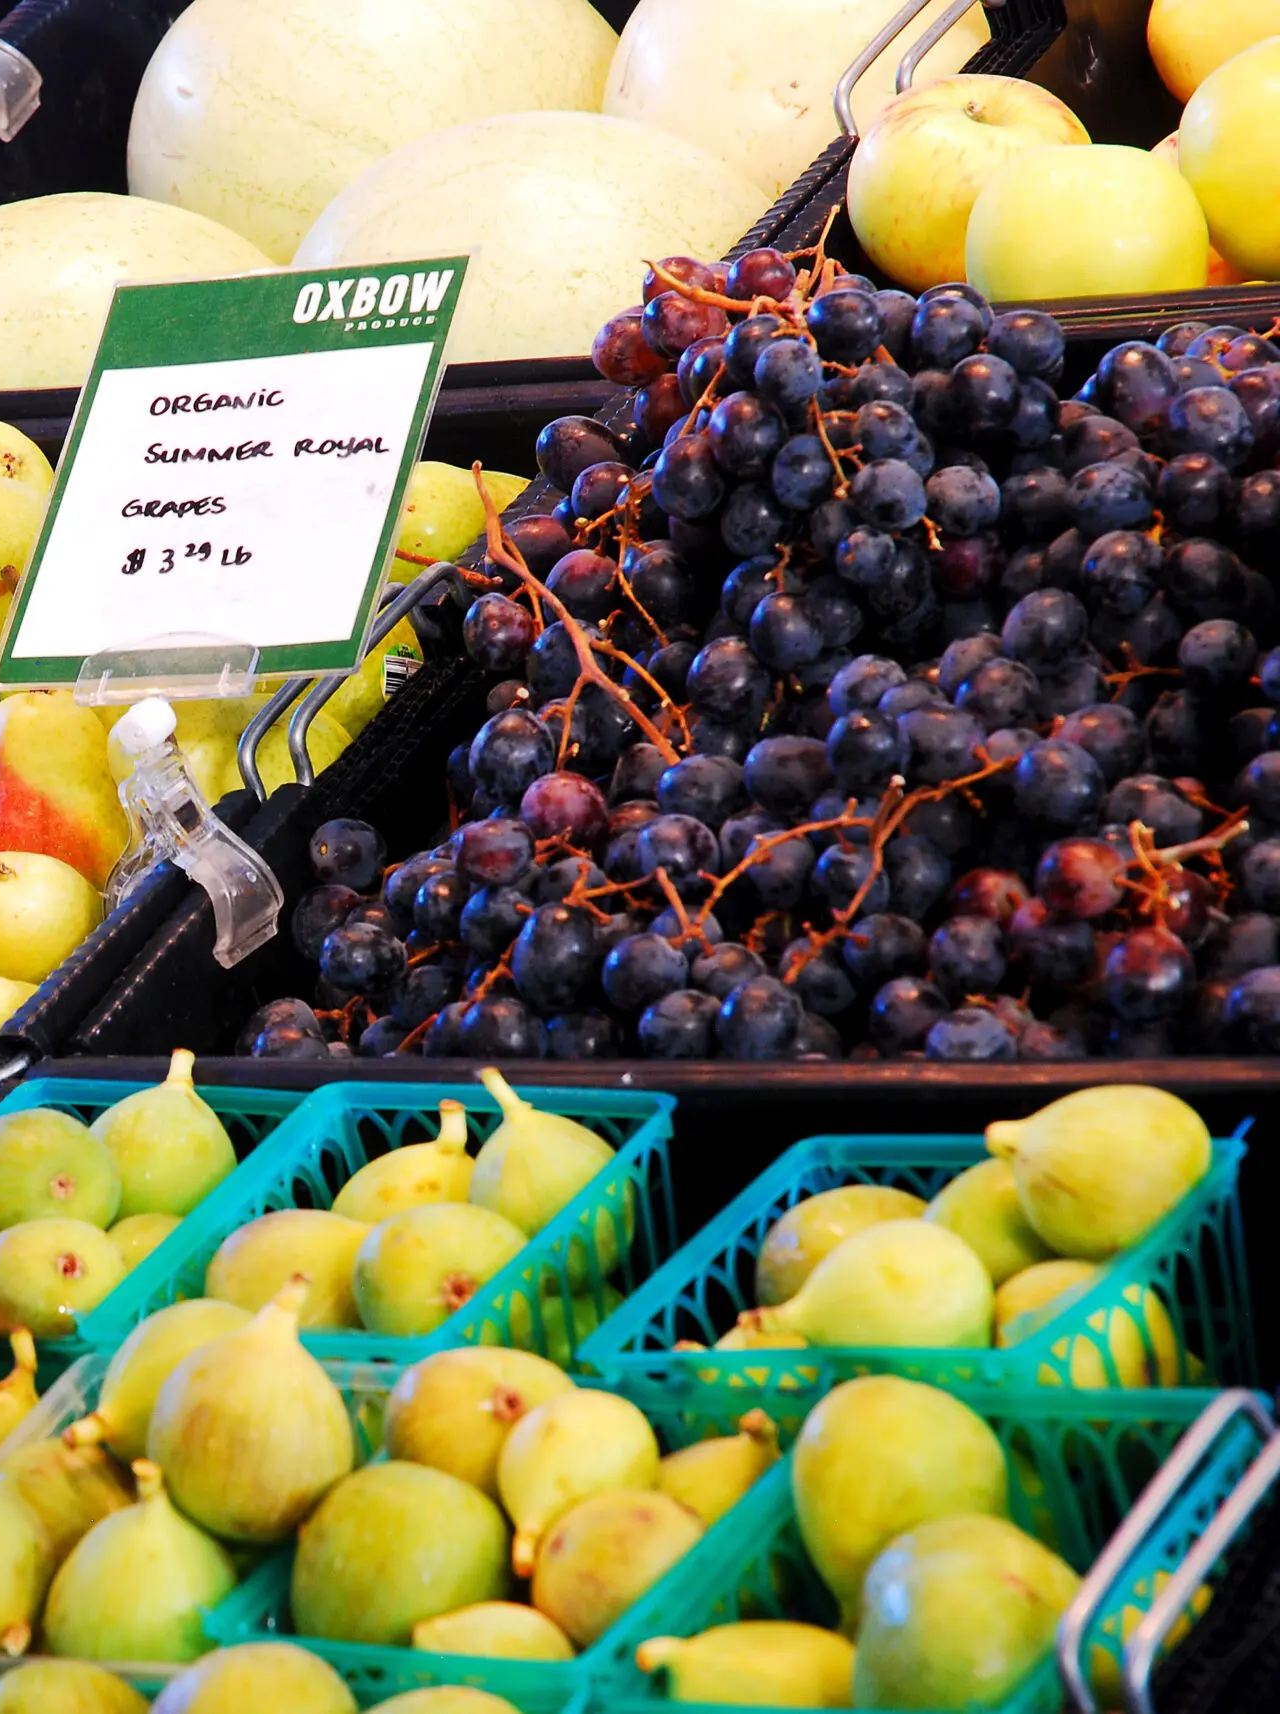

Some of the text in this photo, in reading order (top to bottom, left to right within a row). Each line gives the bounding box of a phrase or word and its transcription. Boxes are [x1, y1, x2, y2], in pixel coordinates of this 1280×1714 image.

[292, 269, 455, 324] OXBOW
[343, 315, 437, 332] PRODUCE
[144, 436, 390, 464] SUMMER ROYAL
[121, 496, 227, 518] GRAPES
